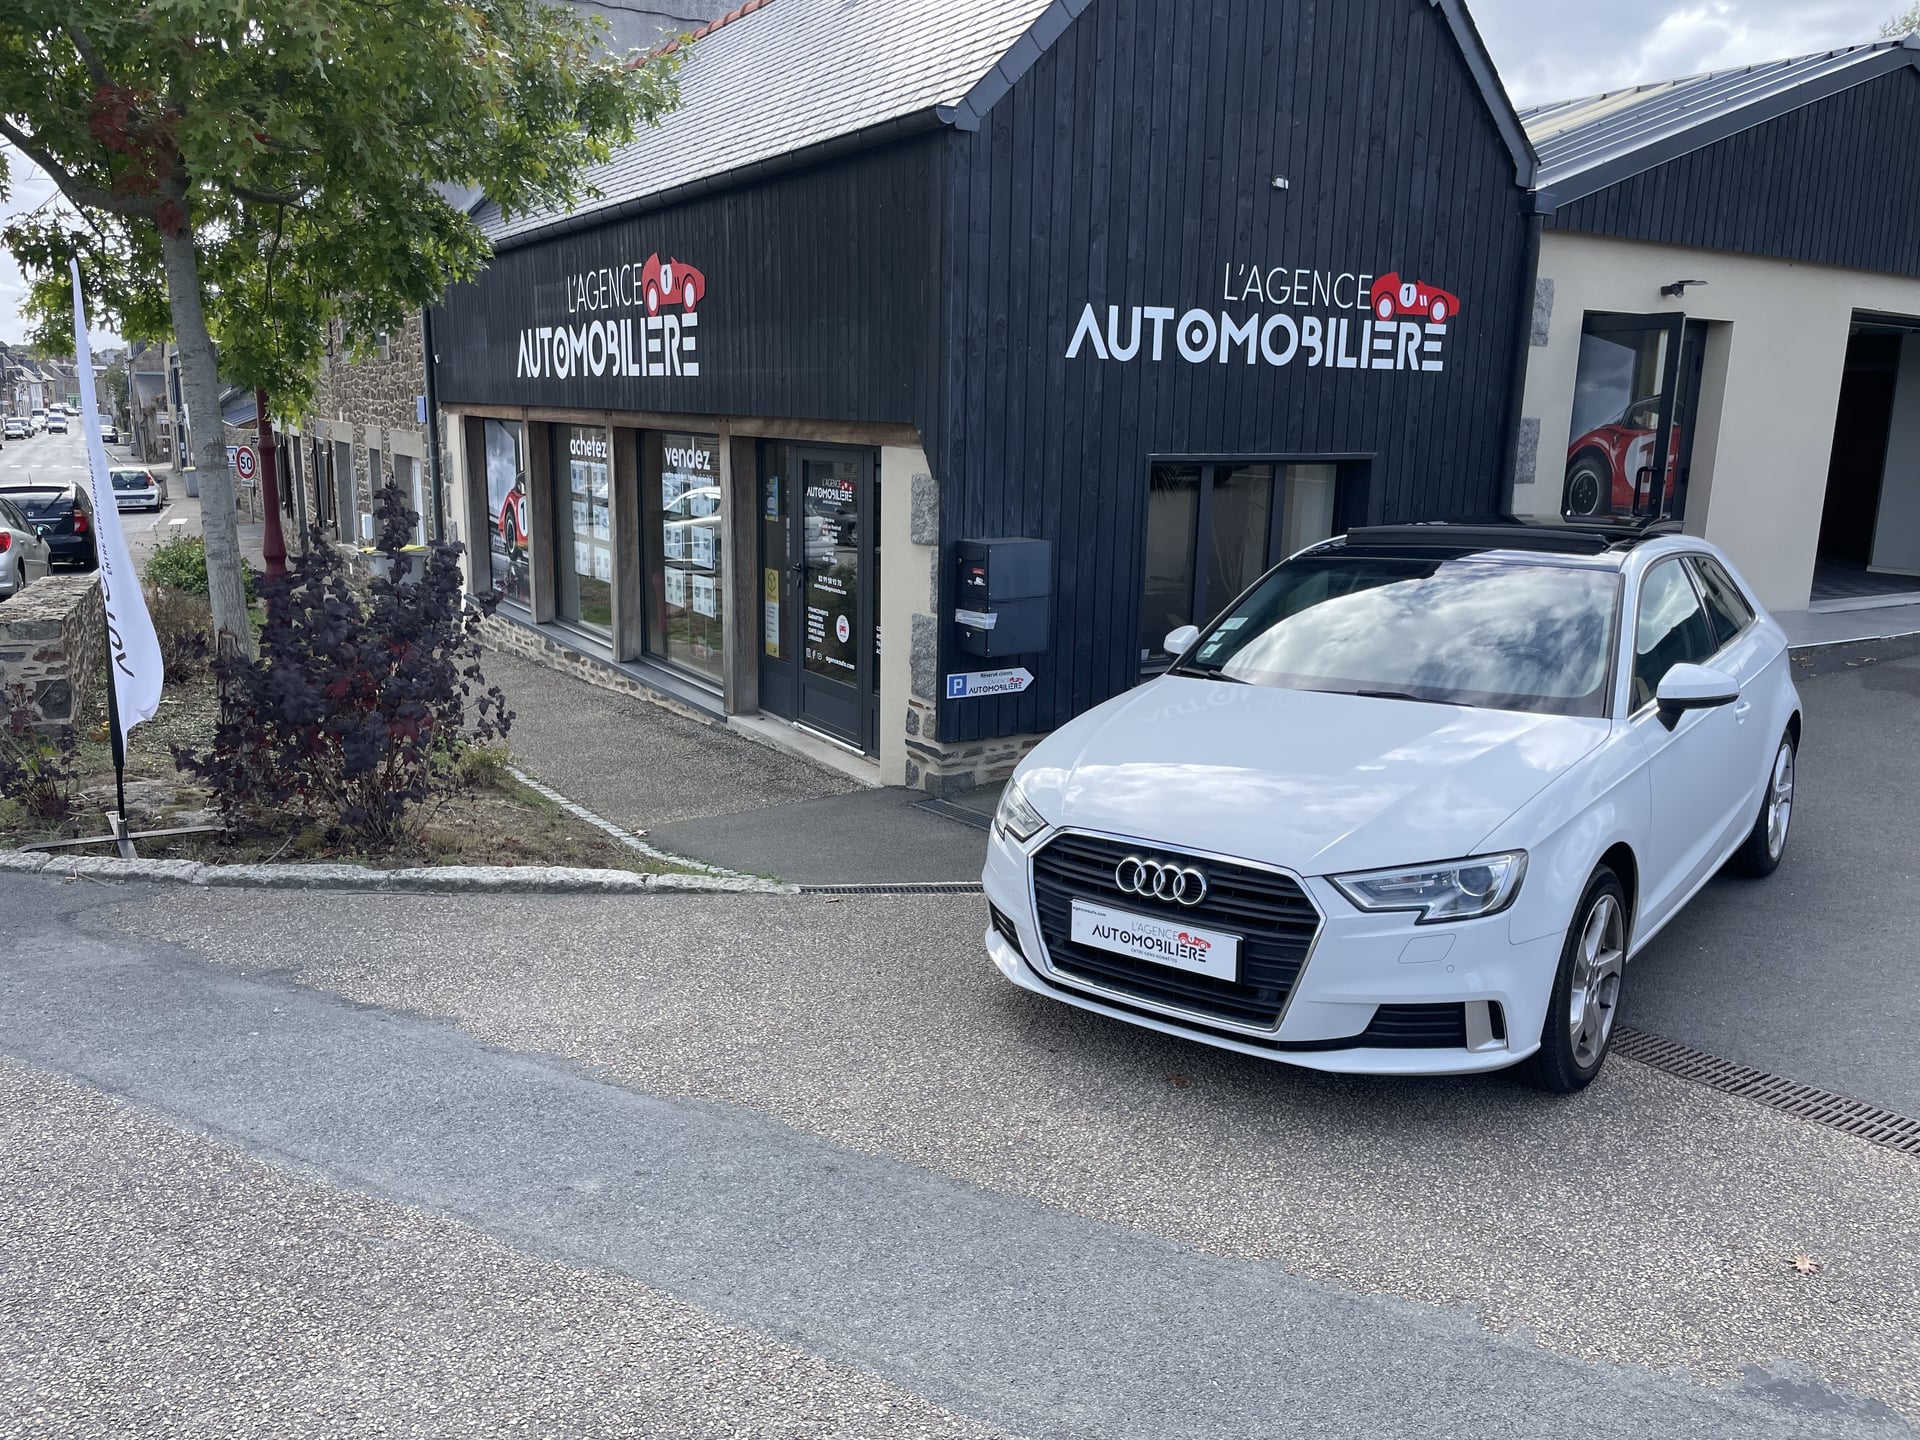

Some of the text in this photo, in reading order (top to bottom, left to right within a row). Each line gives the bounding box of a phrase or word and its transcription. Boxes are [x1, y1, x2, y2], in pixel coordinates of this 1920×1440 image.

[567, 263, 643, 313] L'AGENCE
[1224, 262, 1373, 310] L'AGENCE
[570, 429, 607, 458] achetez
[665, 436, 711, 470] vendez
[240, 456, 252, 470] 50
[520, 501, 526, 530] 1
[954, 679, 963, 694] P
[1131, 921, 1178, 940] L'AGENCE
